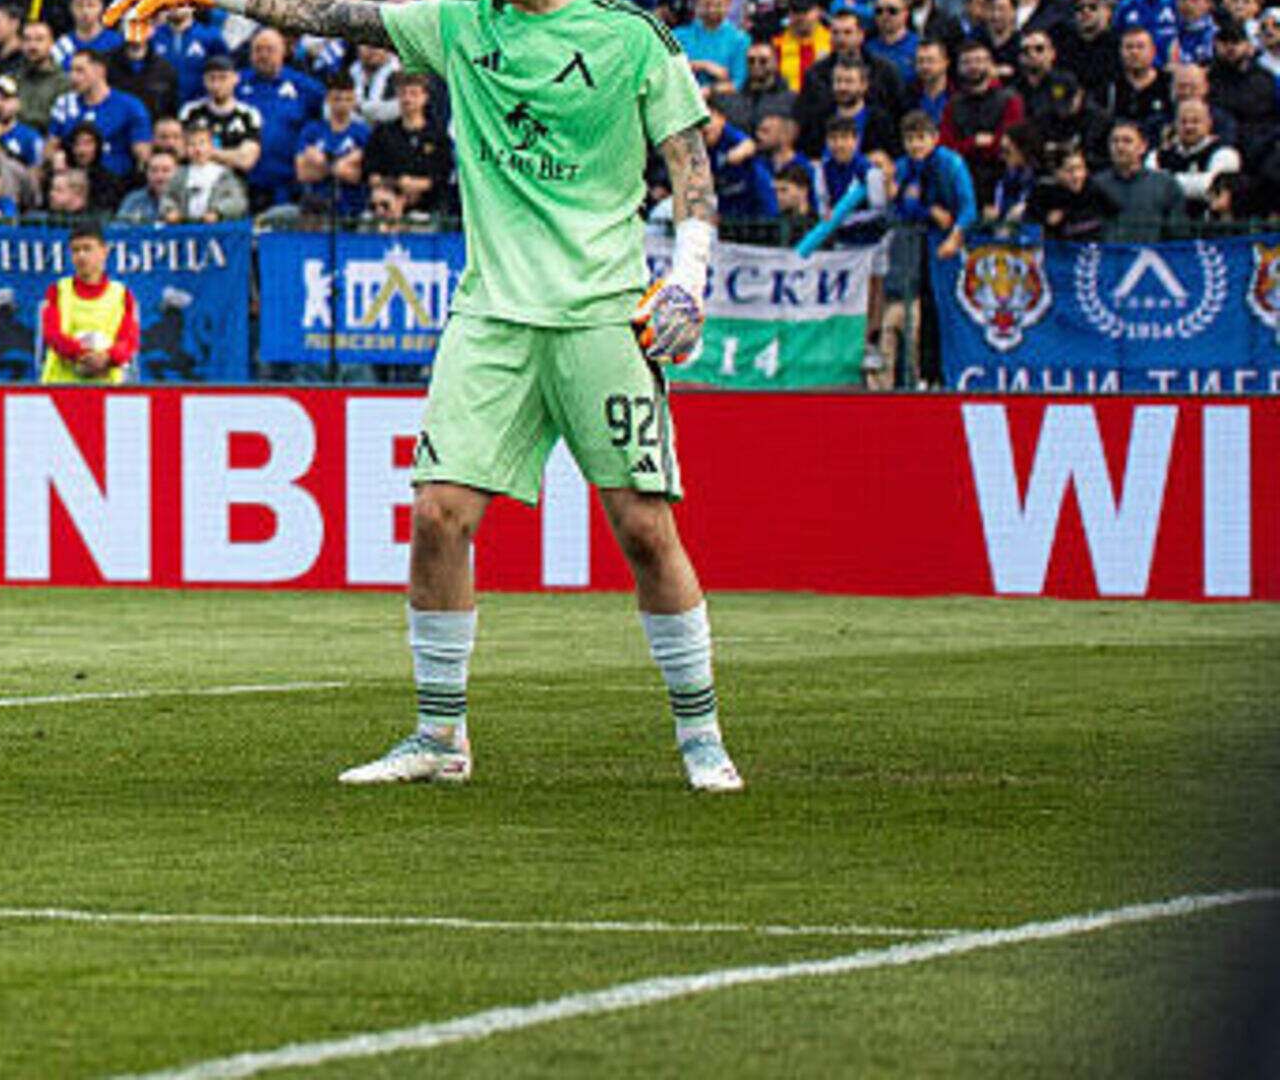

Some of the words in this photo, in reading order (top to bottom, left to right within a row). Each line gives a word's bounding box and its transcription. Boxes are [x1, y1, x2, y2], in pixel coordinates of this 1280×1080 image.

[107, 237, 227, 273] ЪРЦА
[605, 394, 658, 447] 92
[960, 403, 1251, 597] WI
